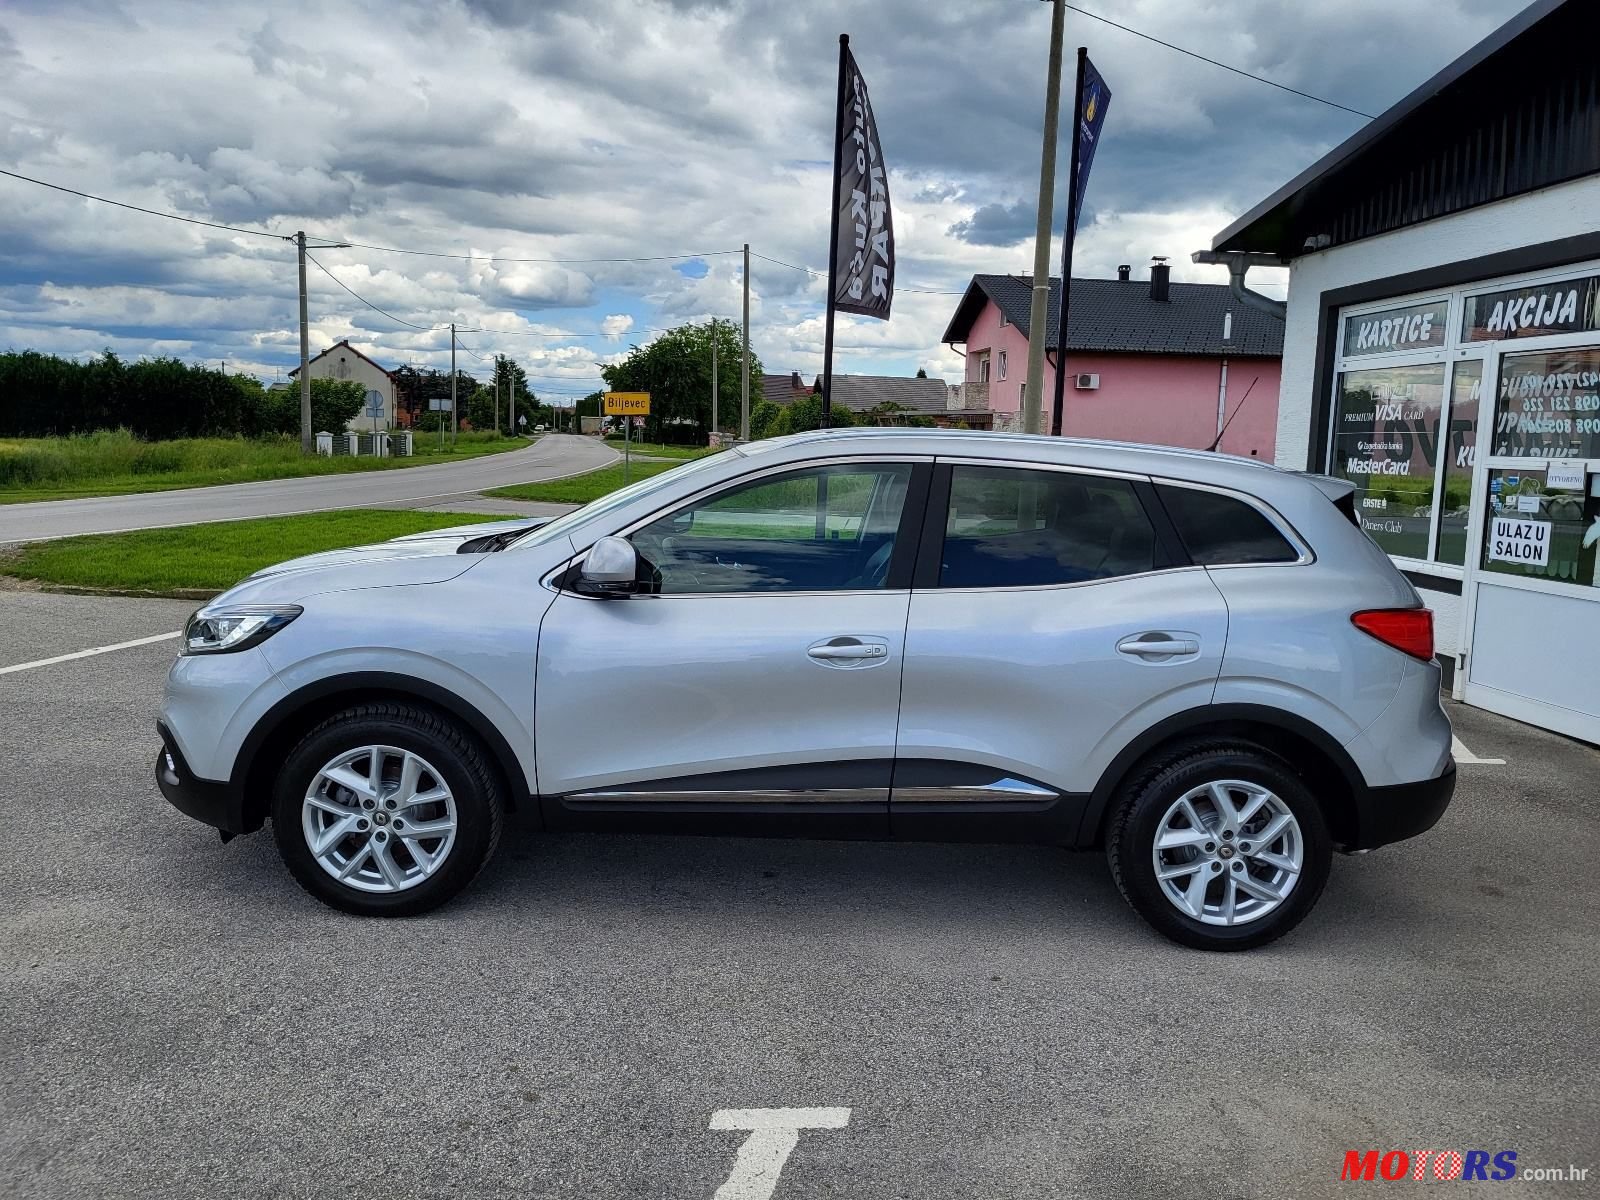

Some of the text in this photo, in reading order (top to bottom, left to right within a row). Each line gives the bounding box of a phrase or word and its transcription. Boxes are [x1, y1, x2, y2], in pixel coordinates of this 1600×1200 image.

[1486, 289, 1578, 333] AKCIJA
[1357, 312, 1434, 349] KARTICE
[608, 397, 646, 411] Biljevec
[1345, 404, 1424, 422] PREMIUM VISA CARD
[1363, 498, 1381, 509] ERSTE
[1361, 518, 1402, 533] Diners Club
[1497, 522, 1545, 541] ULAZ U
[1495, 541, 1543, 561] SALON
